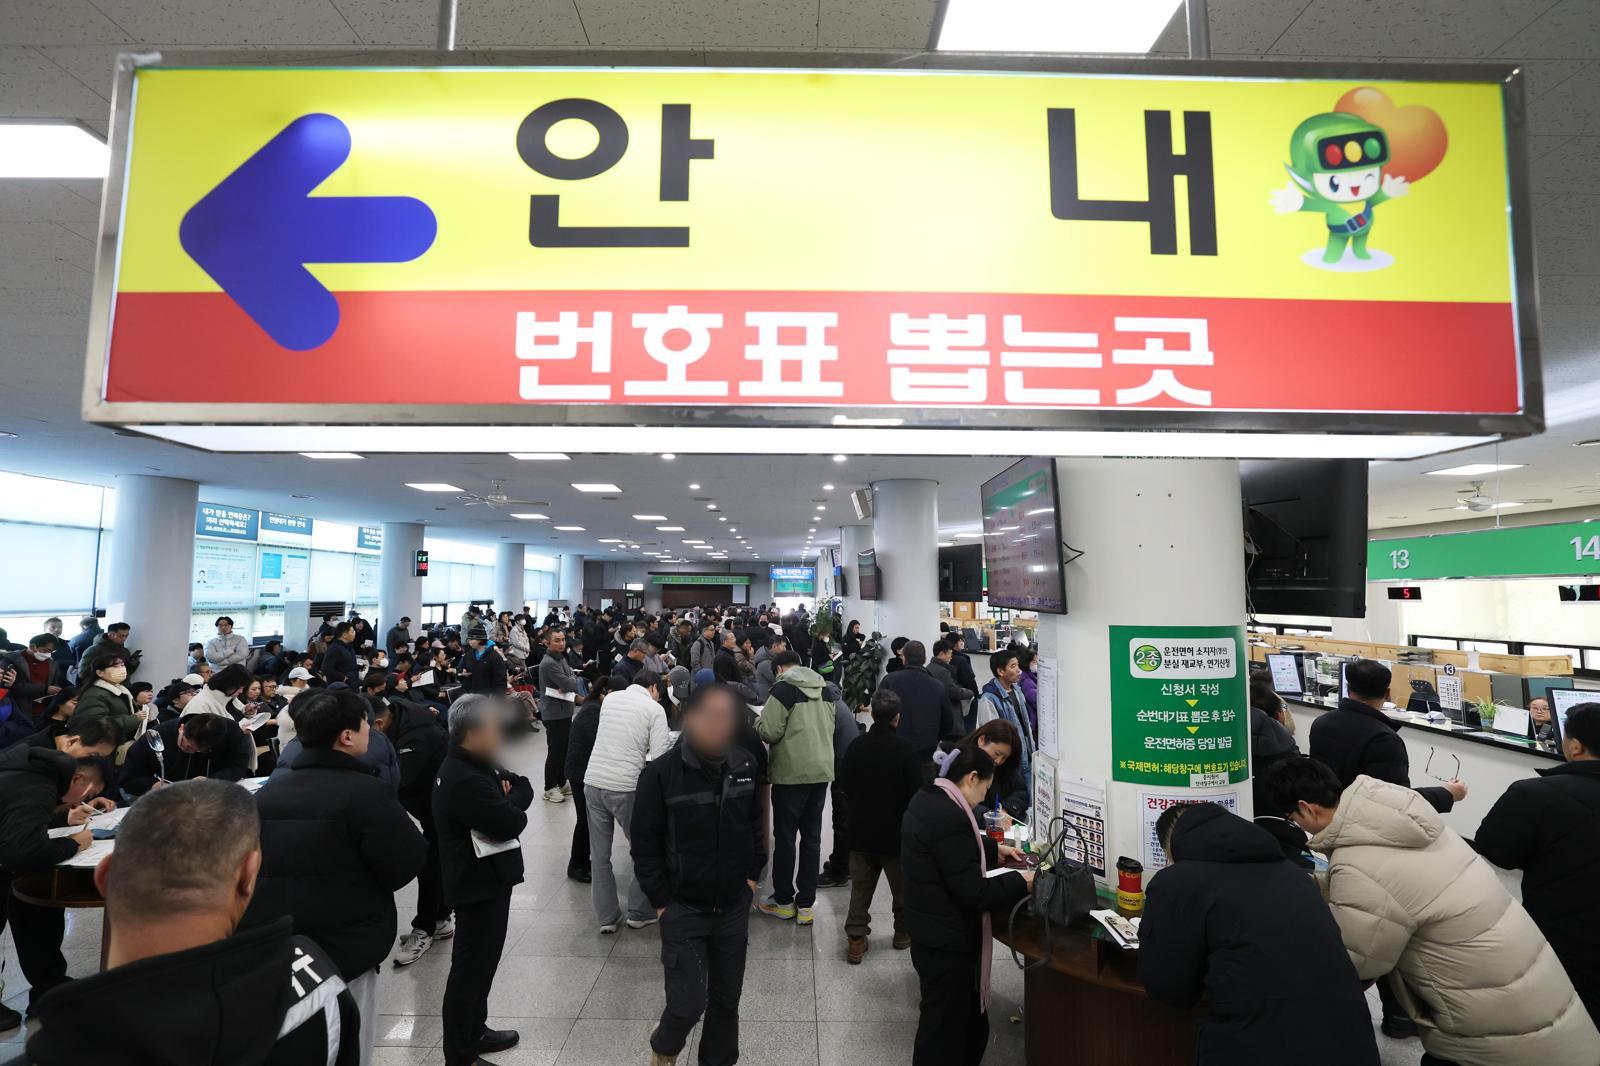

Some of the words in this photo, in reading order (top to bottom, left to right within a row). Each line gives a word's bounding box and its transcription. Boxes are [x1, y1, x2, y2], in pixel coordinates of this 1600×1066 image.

[516, 98, 715, 248] 안
[1047, 108, 1218, 256] 내
[515, 305, 844, 400] 번호표
[887, 313, 1214, 406] 뽑는곳
[1569, 535, 1600, 561] 14
[1390, 549, 1409, 569] 13
[1403, 588, 1410, 598] 5
[1164, 646, 1194, 656] 운전면허
[1136, 650, 1160, 667] 2종
[1164, 659, 1180, 669] 분실
[1181, 659, 1206, 669] 재교부,
[1445, 665, 1454, 675] 13
[1161, 684, 1195, 696] 신청서
[1200, 683, 1219, 695] 작성
[1136, 710, 1189, 723] 순번대기표
[1191, 710, 1210, 723] 뽑은
[1211, 710, 1220, 722] 후
[1222, 709, 1236, 721] 접수
[1144, 736, 1196, 750] 운전면허증
[1197, 737, 1216, 750] 당일
[1217, 736, 1232, 749] 발급
